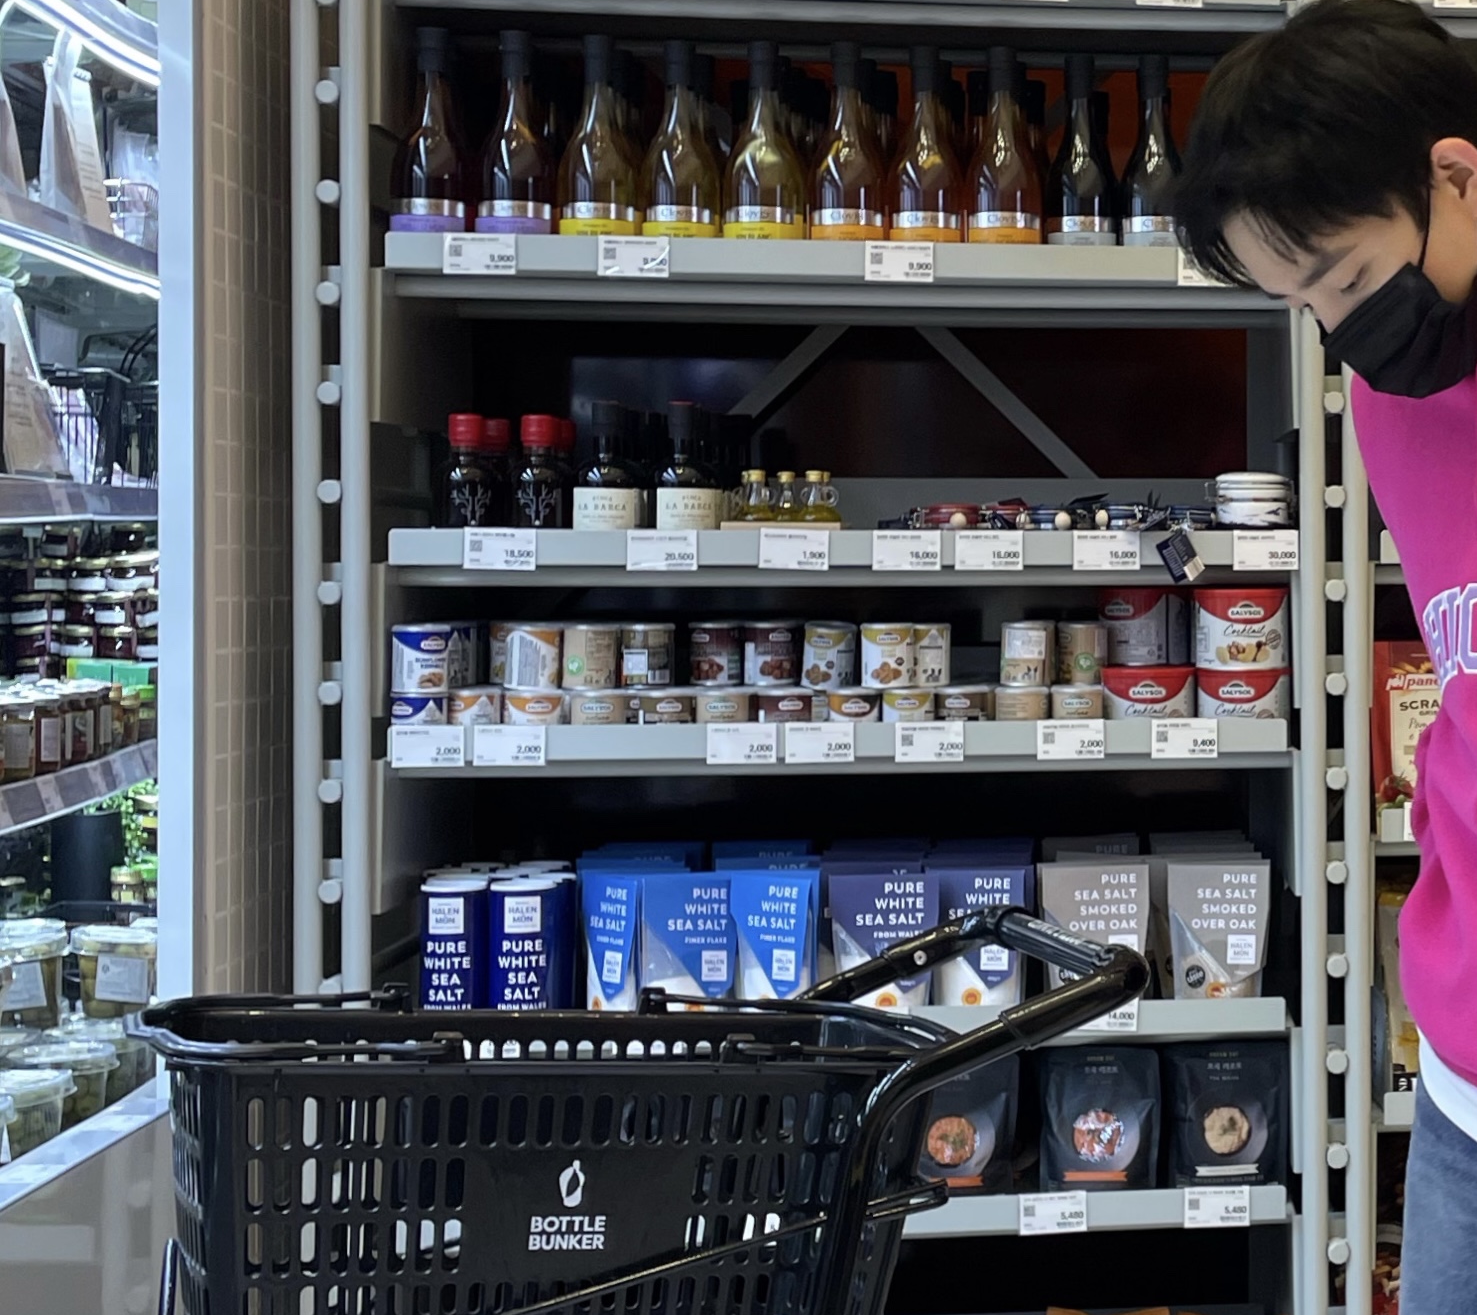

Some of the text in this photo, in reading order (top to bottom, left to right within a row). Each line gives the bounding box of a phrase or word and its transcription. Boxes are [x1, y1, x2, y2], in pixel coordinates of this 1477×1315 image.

[1229, 608, 1264, 617] SALYSOL
[1223, 623, 1266, 638] Cocktail
[1131, 688, 1165, 697] SALYSOL
[1220, 688, 1254, 697] SALYSOL
[1124, 703, 1168, 717] Cocktail
[1214, 703, 1257, 717] Cocktail
[1400, 699, 1440, 712] SCRA
[516, 745, 542, 755] 2,000
[749, 744, 774, 753] 2,000
[827, 742, 852, 752] 2,000
[938, 742, 963, 751] 2,000
[1079, 739, 1104, 749] 2,000
[435, 747, 461, 756] 2,000
[974, 877, 1011, 890] PURE
[1101, 873, 1137, 884] PURE
[1223, 873, 1257, 884] PURE
[606, 886, 628, 901] PURE
[693, 887, 728, 900] PURE
[768, 885, 799, 900] PURE
[884, 881, 925, 895] PURE
[1074, 888, 1137, 901] SEA SALT
[1197, 888, 1257, 899] SEA SALT
[874, 896, 925, 910] WHITE
[965, 892, 1011, 905] WHITE
[508, 905, 538, 916] HALEN
[600, 901, 627, 917] WHITE
[685, 902, 728, 916] WHITE
[761, 899, 797, 915] WHITE
[1080, 903, 1137, 916] SMOKED
[1202, 903, 1257, 915] SMOKED
[590, 915, 627, 933] SEA SALT
[667, 918, 728, 932] SEA SALT
[747, 915, 796, 931] SEA SALT
[855, 912, 925, 927] SEA SALT
[1069, 918, 1138, 932] OVER OAK
[1191, 918, 1257, 930] OVER OAK
[426, 941, 467, 954] PURE
[501, 939, 543, 953] PURE
[423, 956, 471, 970] WHITE
[497, 954, 547, 969] WHITE
[431, 973, 461, 986] SEA
[507, 971, 538, 985] SEA
[428, 988, 465, 1002] SALT
[503, 986, 541, 1001] SALT
[530, 1216, 606, 1233] BOTTLE
[527, 1234, 606, 1251] BUNKER
